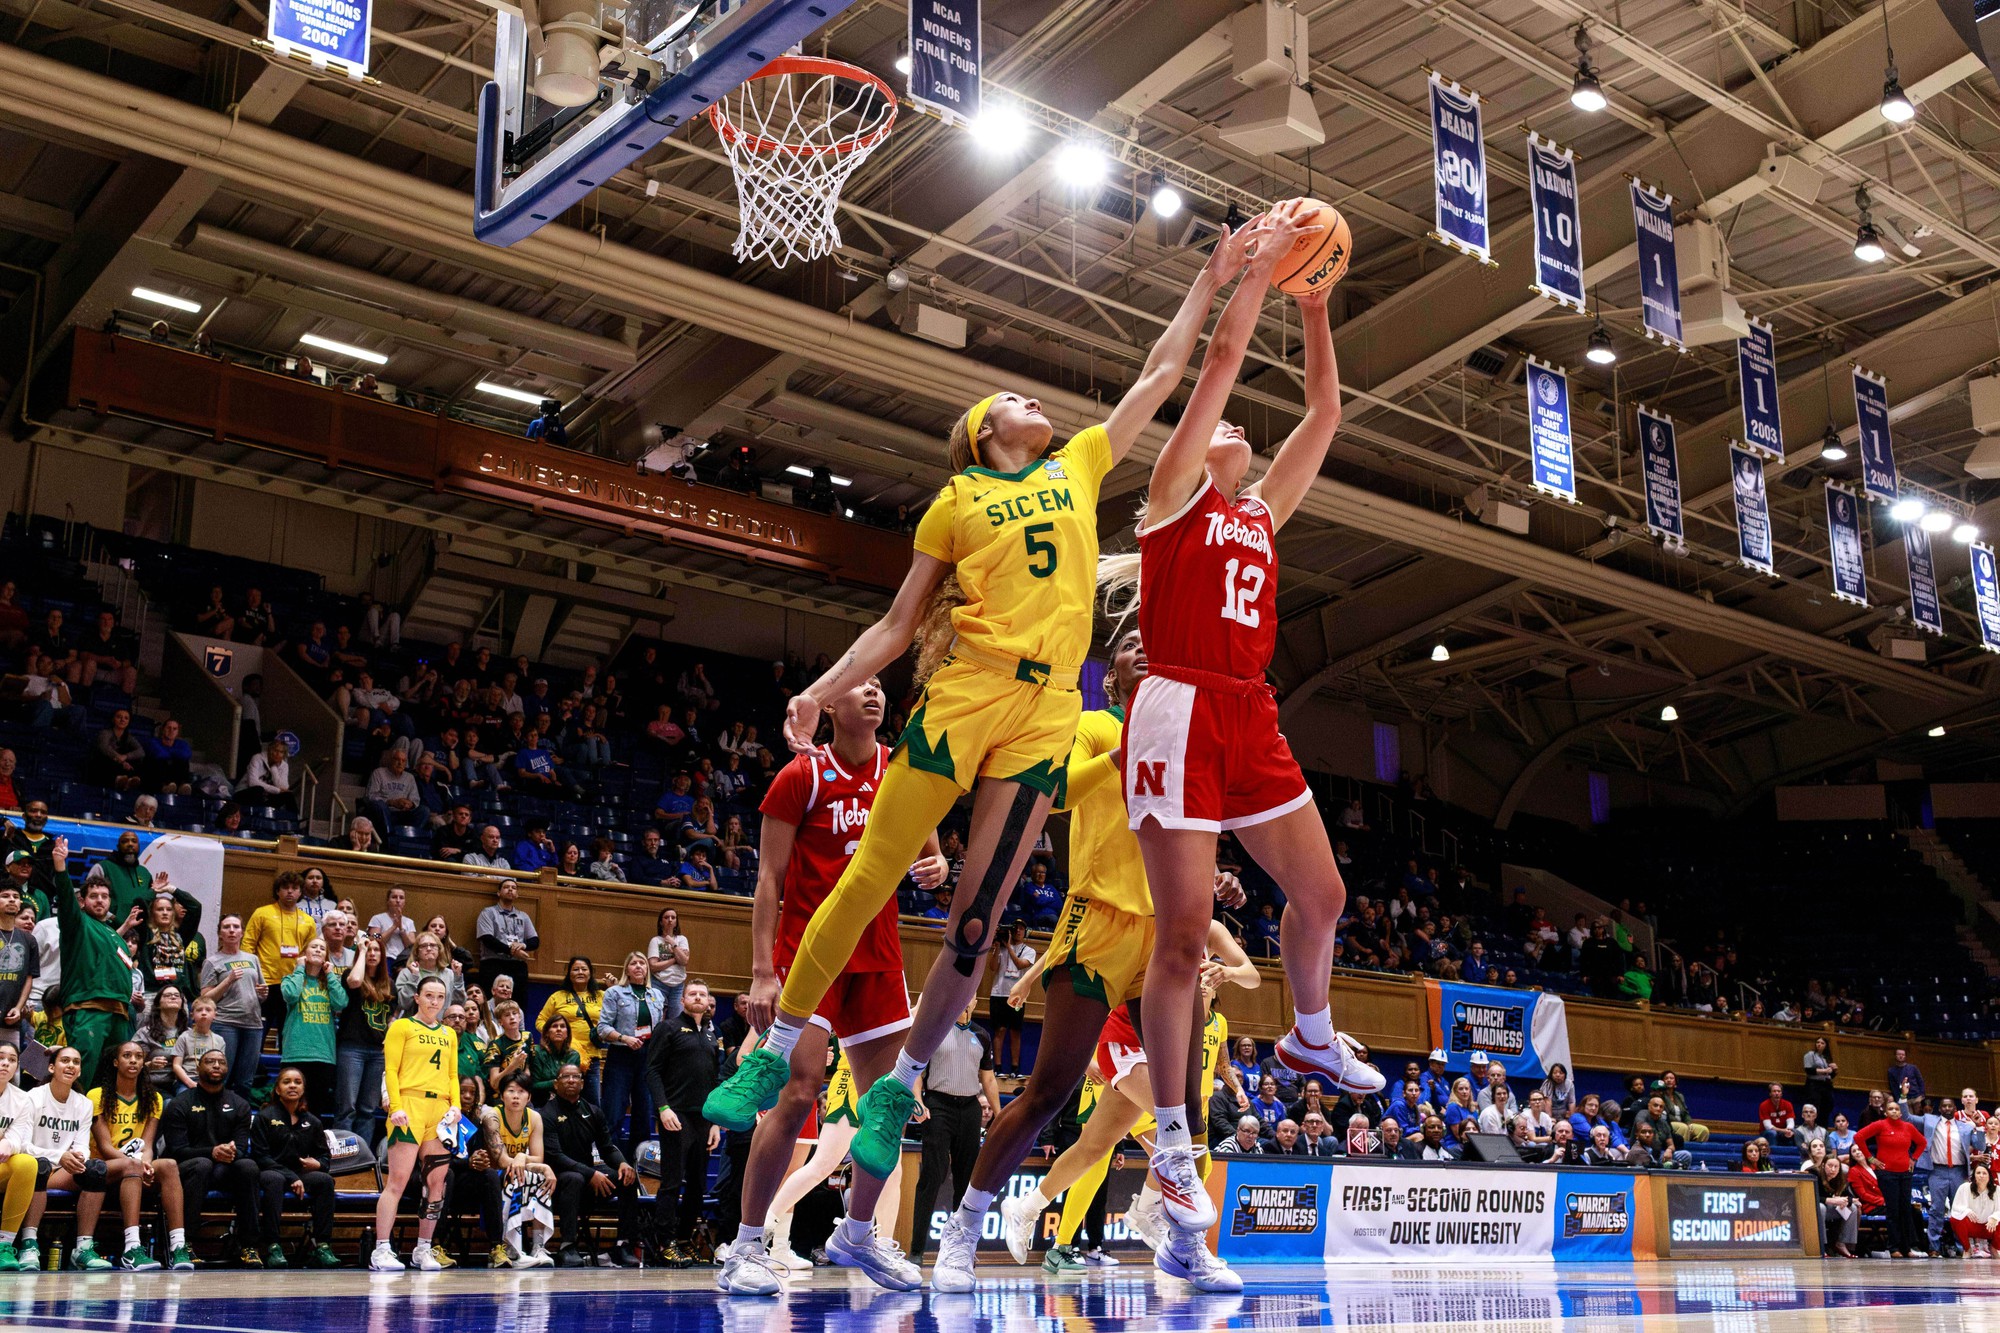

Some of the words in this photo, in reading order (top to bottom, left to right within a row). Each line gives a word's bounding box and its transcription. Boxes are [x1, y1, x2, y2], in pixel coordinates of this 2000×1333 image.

[289, 1, 324, 20] REGULAR
[325, 13, 355, 30] SEASON
[295, 12, 347, 37] TOURNAMENT
[933, 1, 961, 25] NCAA
[301, 26, 338, 50] 2004
[922, 18, 972, 52] WOMEN'S
[915, 38, 947, 62] FINAL
[950, 52, 977, 76] FOUR
[934, 80, 960, 103] 2006
[1440, 106, 1474, 143] BEARD
[1442, 149, 1476, 195] 20
[1542, 207, 1572, 248] 10
[1636, 206, 1673, 243] WILLIAMS
[1305, 243, 1344, 286] NCAA
[1653, 253, 1664, 287] 1
[1753, 377, 1768, 414] 1
[1537, 405, 1563, 423] ATLANTIC
[1541, 416, 1560, 432] COAST
[1533, 424, 1570, 445] CONFERENCE
[1751, 419, 1778, 444] 2003
[1536, 445, 1570, 465] CHAMPIONS
[1539, 435, 1566, 453] WOMEN'S
[1870, 429, 1884, 464] 1
[1649, 452, 1671, 469] ATLANTIC
[1653, 463, 1669, 477] COAST
[1646, 470, 1678, 489] CONFERENCE
[1651, 482, 1674, 498] WOMEN'S
[1870, 469, 1894, 491] 2004
[477, 452, 599, 497] CAMERON
[609, 483, 698, 523] INDOOR
[706, 508, 804, 547] STADIUM
[986, 488, 1074, 527] SIC'EM
[1024, 522, 1057, 579] 5
[1221, 558, 1266, 629] 12
[1845, 581, 1858, 593] 2011
[211, 655, 224, 672] 7
[1134, 760, 1168, 797] N
[827, 797, 871, 835] Nebr
[0, 972, 18, 981] YLOR
[303, 1013, 330, 1024] BEARS
[1466, 1007, 1504, 1028] MARCH
[1472, 1026, 1523, 1049] MADNESS
[430, 1049, 441, 1070] 4
[1251, 1189, 1294, 1207] MARCH
[1342, 1185, 1392, 1212] FIRST
[1392, 1195, 1405, 1205] AND
[1407, 1187, 1471, 1213] SECOND
[1476, 1189, 1545, 1213] ROUNDS
[1577, 1196, 1610, 1213] MARCH
[1704, 1192, 1746, 1214] FIRST
[1748, 1200, 1760, 1209] AND
[1256, 1208, 1317, 1226] MADNESS
[1582, 1212, 1627, 1229] MADNESS
[1354, 1228, 1376, 1236] HOSTED
[1378, 1228, 1386, 1237] BY
[1390, 1221, 1431, 1244] DUKE
[1435, 1222, 1521, 1245] UNIVERSITY
[1672, 1219, 1730, 1242] SECOND
[1734, 1220, 1791, 1243] ROUNDS
